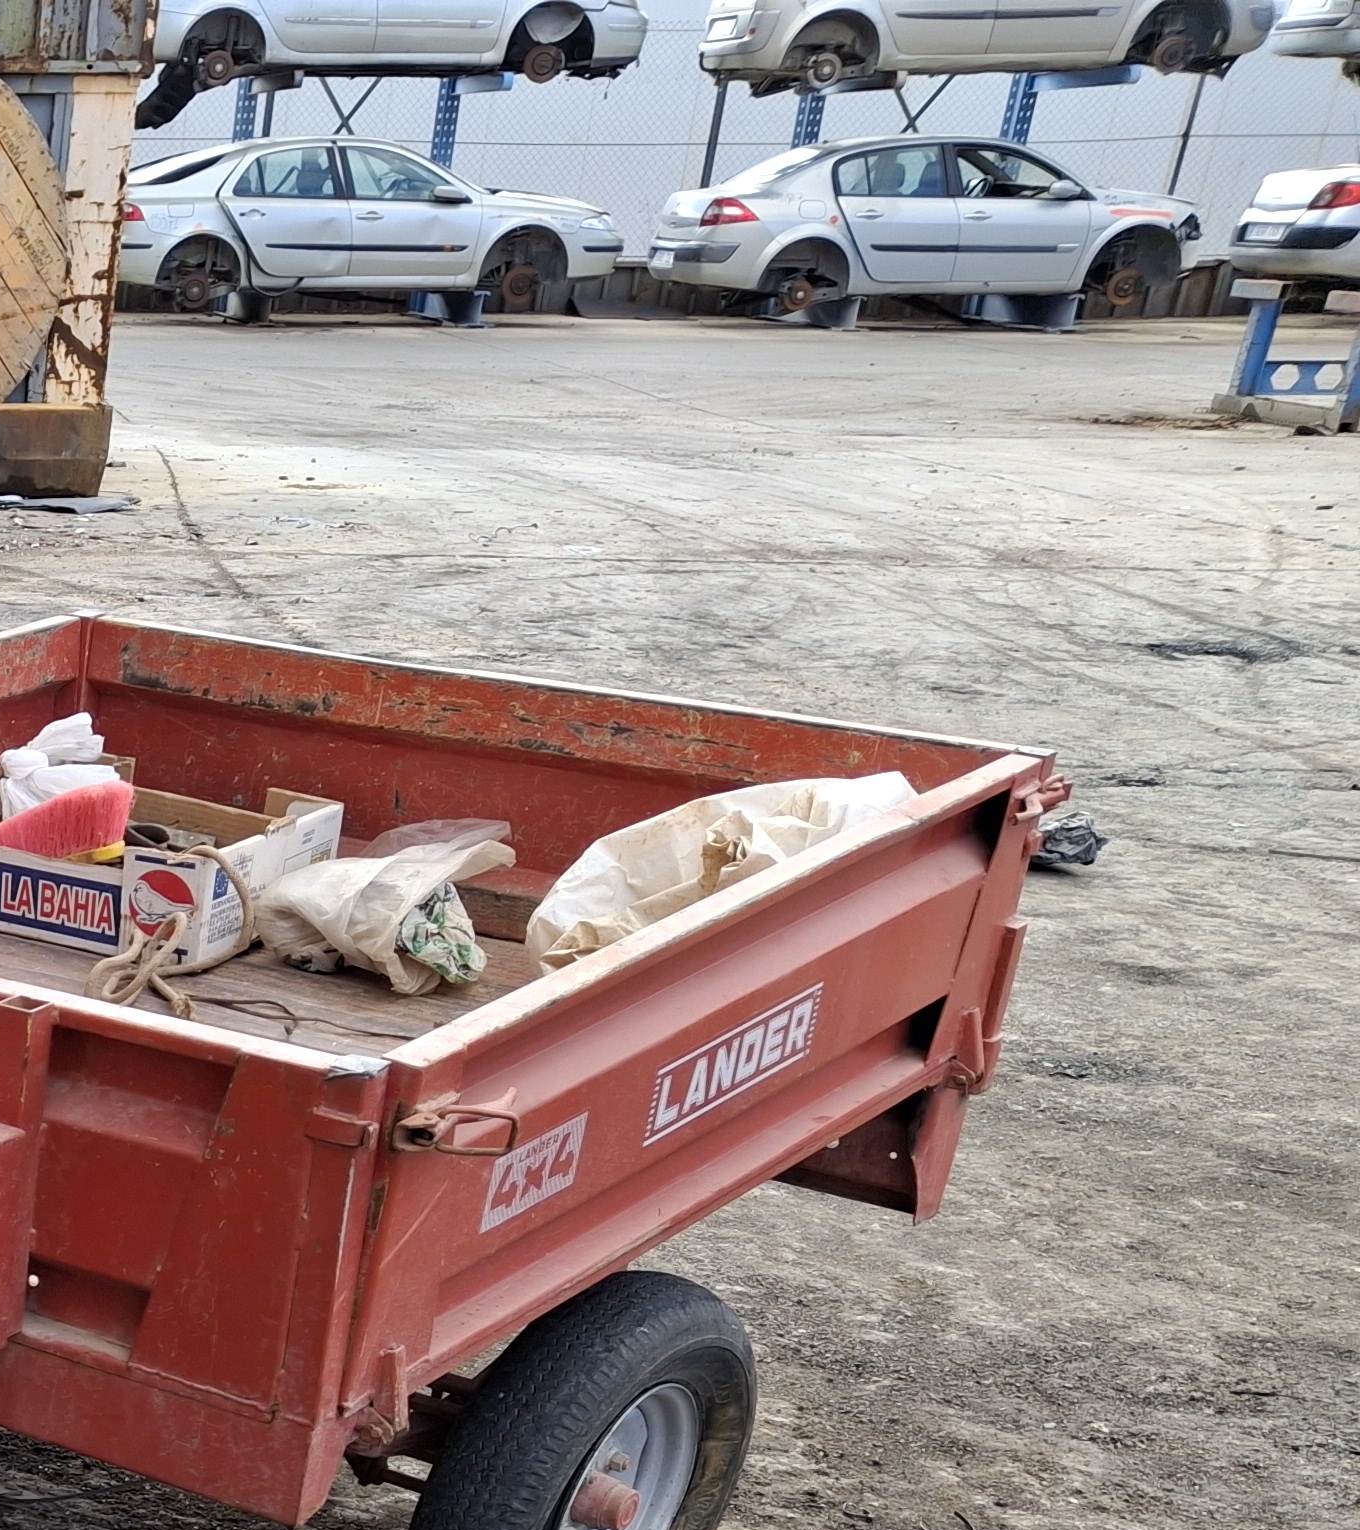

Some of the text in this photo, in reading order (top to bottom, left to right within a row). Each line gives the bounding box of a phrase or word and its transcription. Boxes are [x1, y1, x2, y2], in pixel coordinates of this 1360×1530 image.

[0, 872, 116, 936] LA BAHIA
[654, 998, 814, 1131] LANDER
[518, 1133, 560, 1162] LANDER
